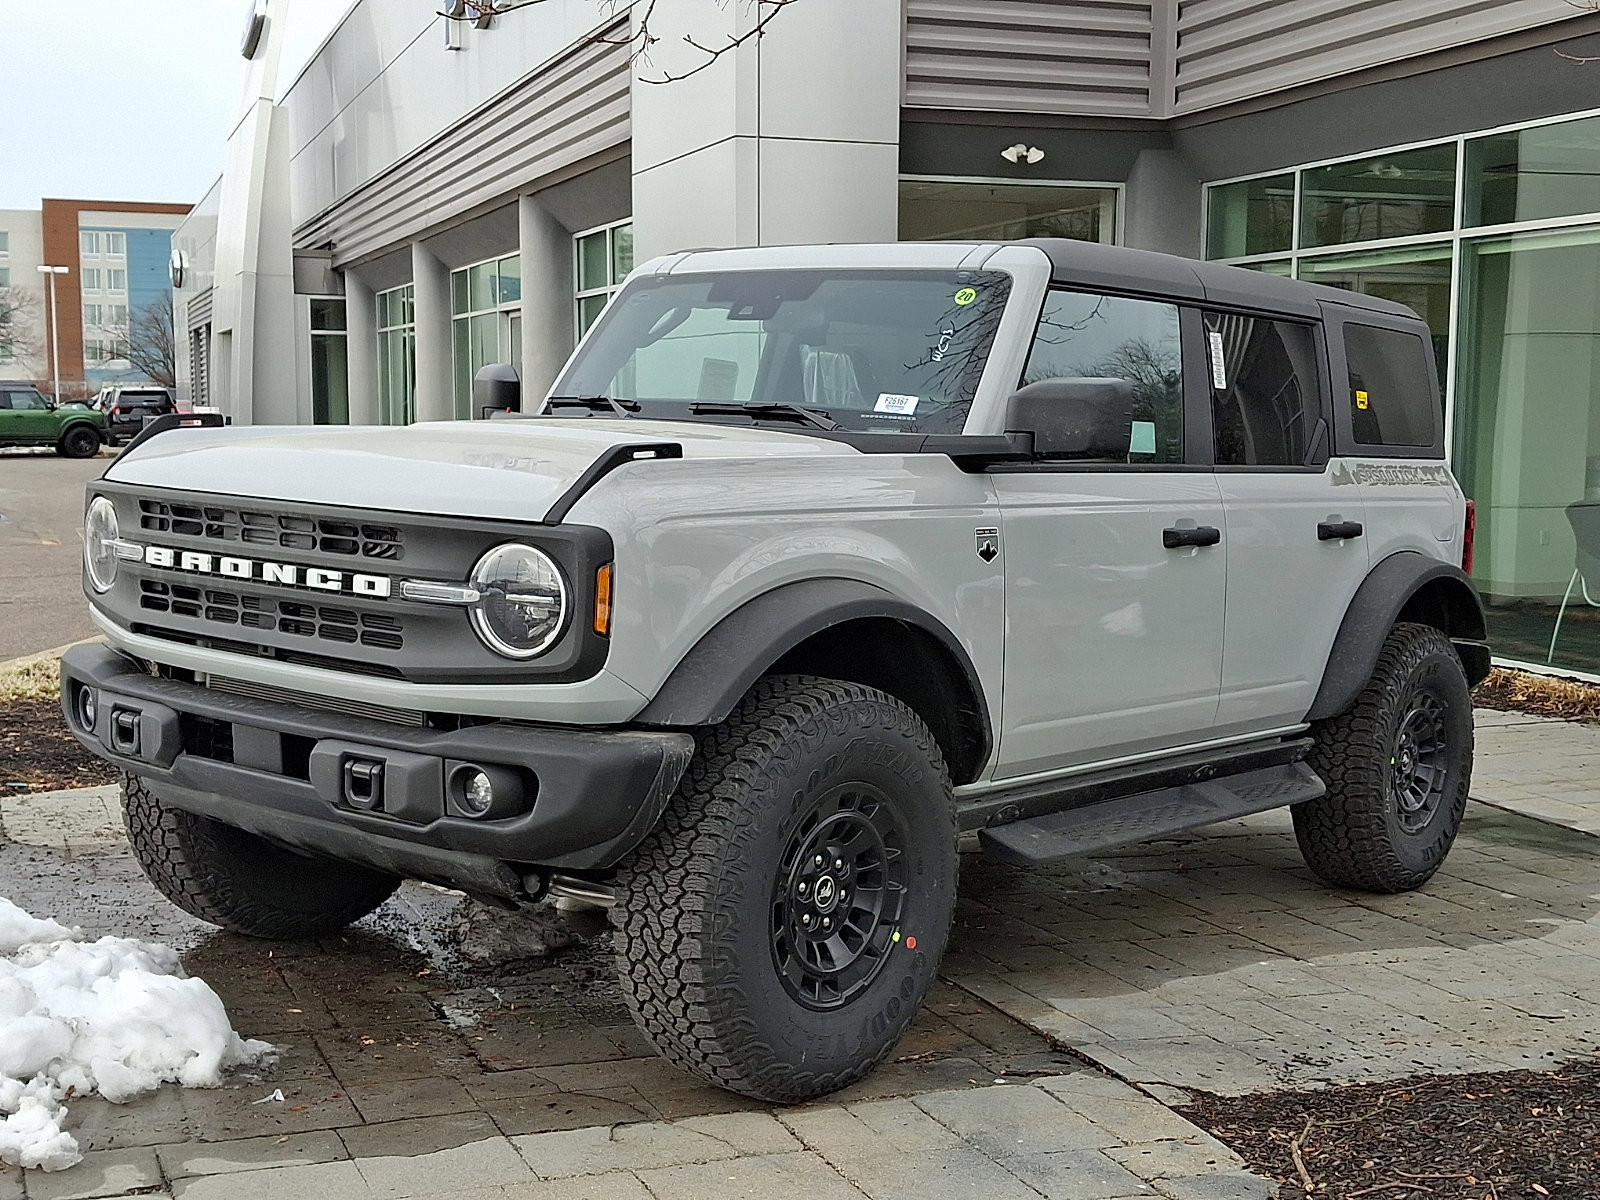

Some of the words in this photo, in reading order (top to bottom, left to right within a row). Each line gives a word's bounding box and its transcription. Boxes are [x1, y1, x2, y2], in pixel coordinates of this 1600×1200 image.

[957, 291, 973, 301] 20
[1358, 467, 1420, 482] SASQUATCH
[145, 546, 391, 597] BRONCO
